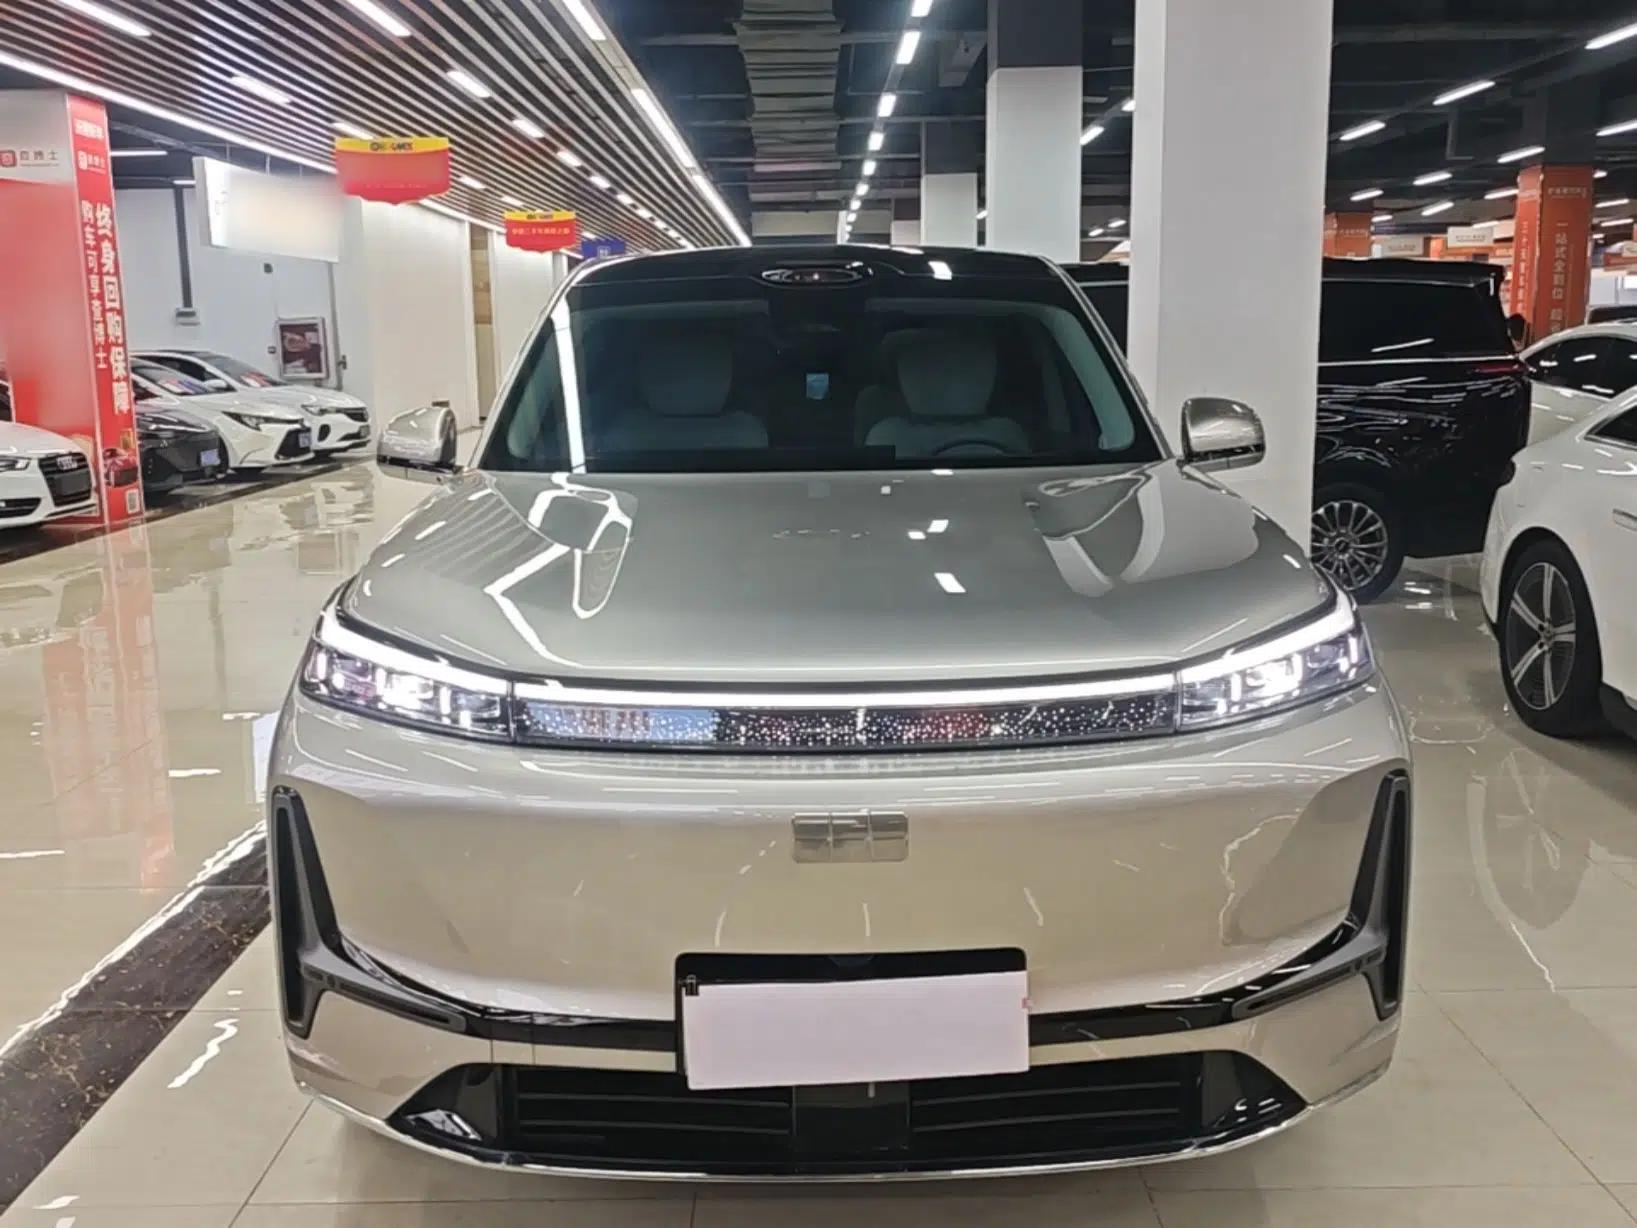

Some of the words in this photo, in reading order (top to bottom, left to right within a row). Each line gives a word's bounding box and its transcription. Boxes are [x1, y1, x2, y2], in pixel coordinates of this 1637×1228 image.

[95, 202, 131, 416] 终身回购保障
